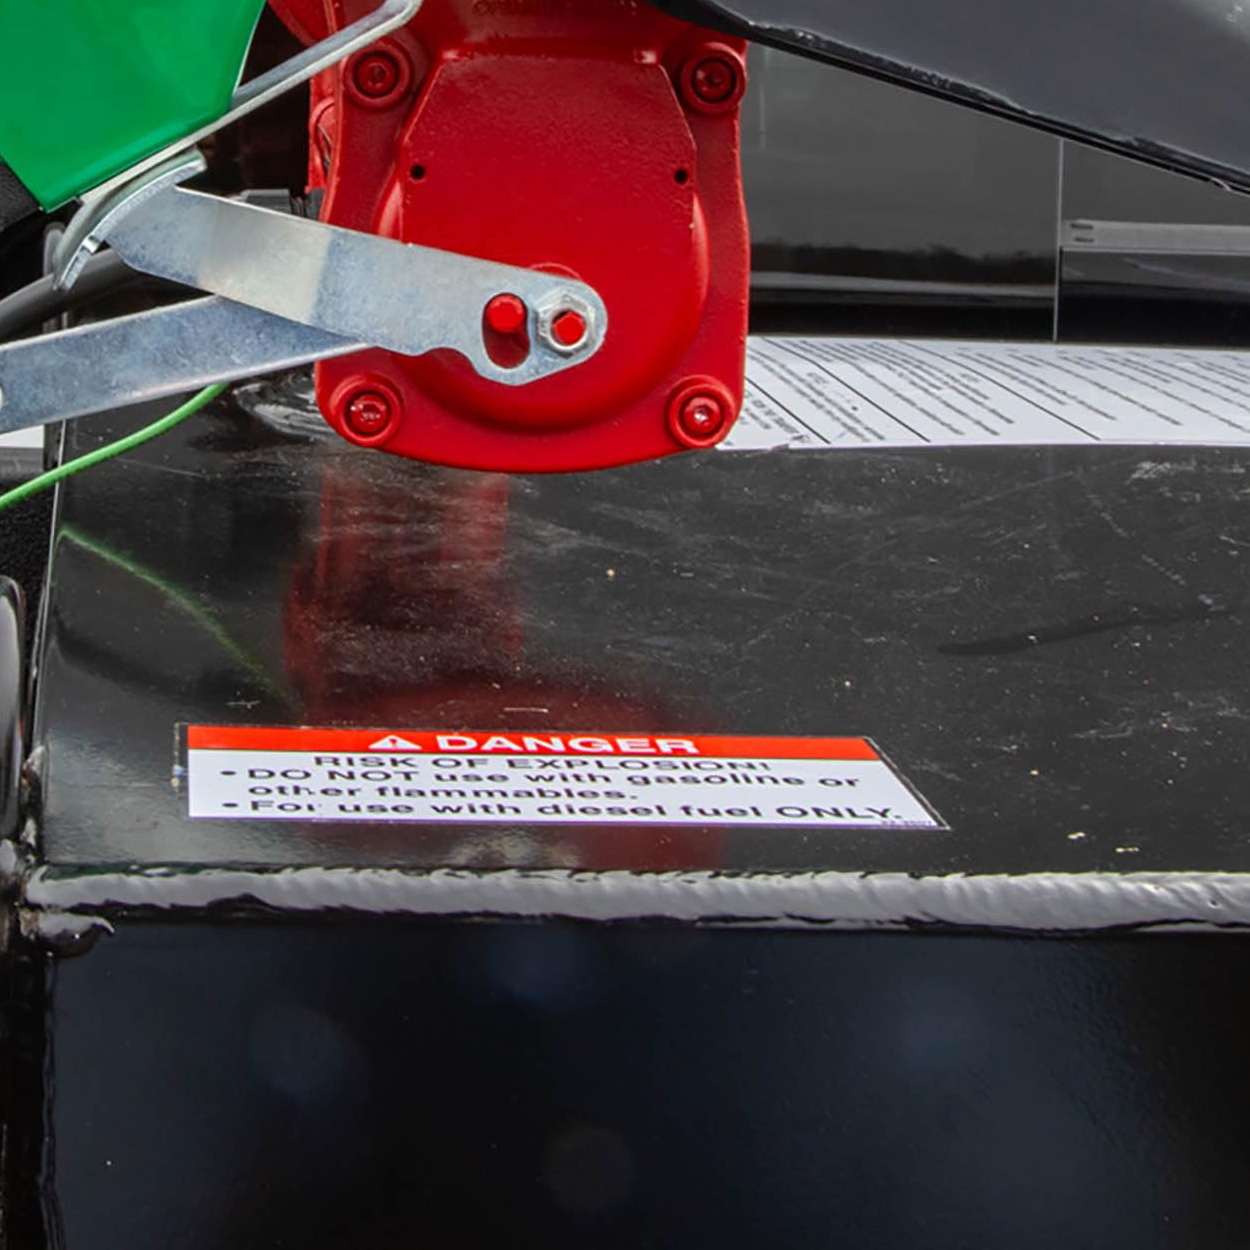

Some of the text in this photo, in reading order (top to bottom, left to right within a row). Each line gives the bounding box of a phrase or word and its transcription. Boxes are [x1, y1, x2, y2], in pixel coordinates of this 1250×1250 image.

[435, 735, 699, 754] DANGER
[314, 756, 771, 771] RISK OF EXPLOSION!
[248, 768, 860, 788] DO NOT use with gasoline or
[248, 784, 638, 800] other flammables.
[337, 803, 415, 814] use
[430, 803, 522, 815] with
[536, 804, 667, 817] diesel
[680, 804, 764, 817] fuel
[776, 805, 903, 819] ONLY.
